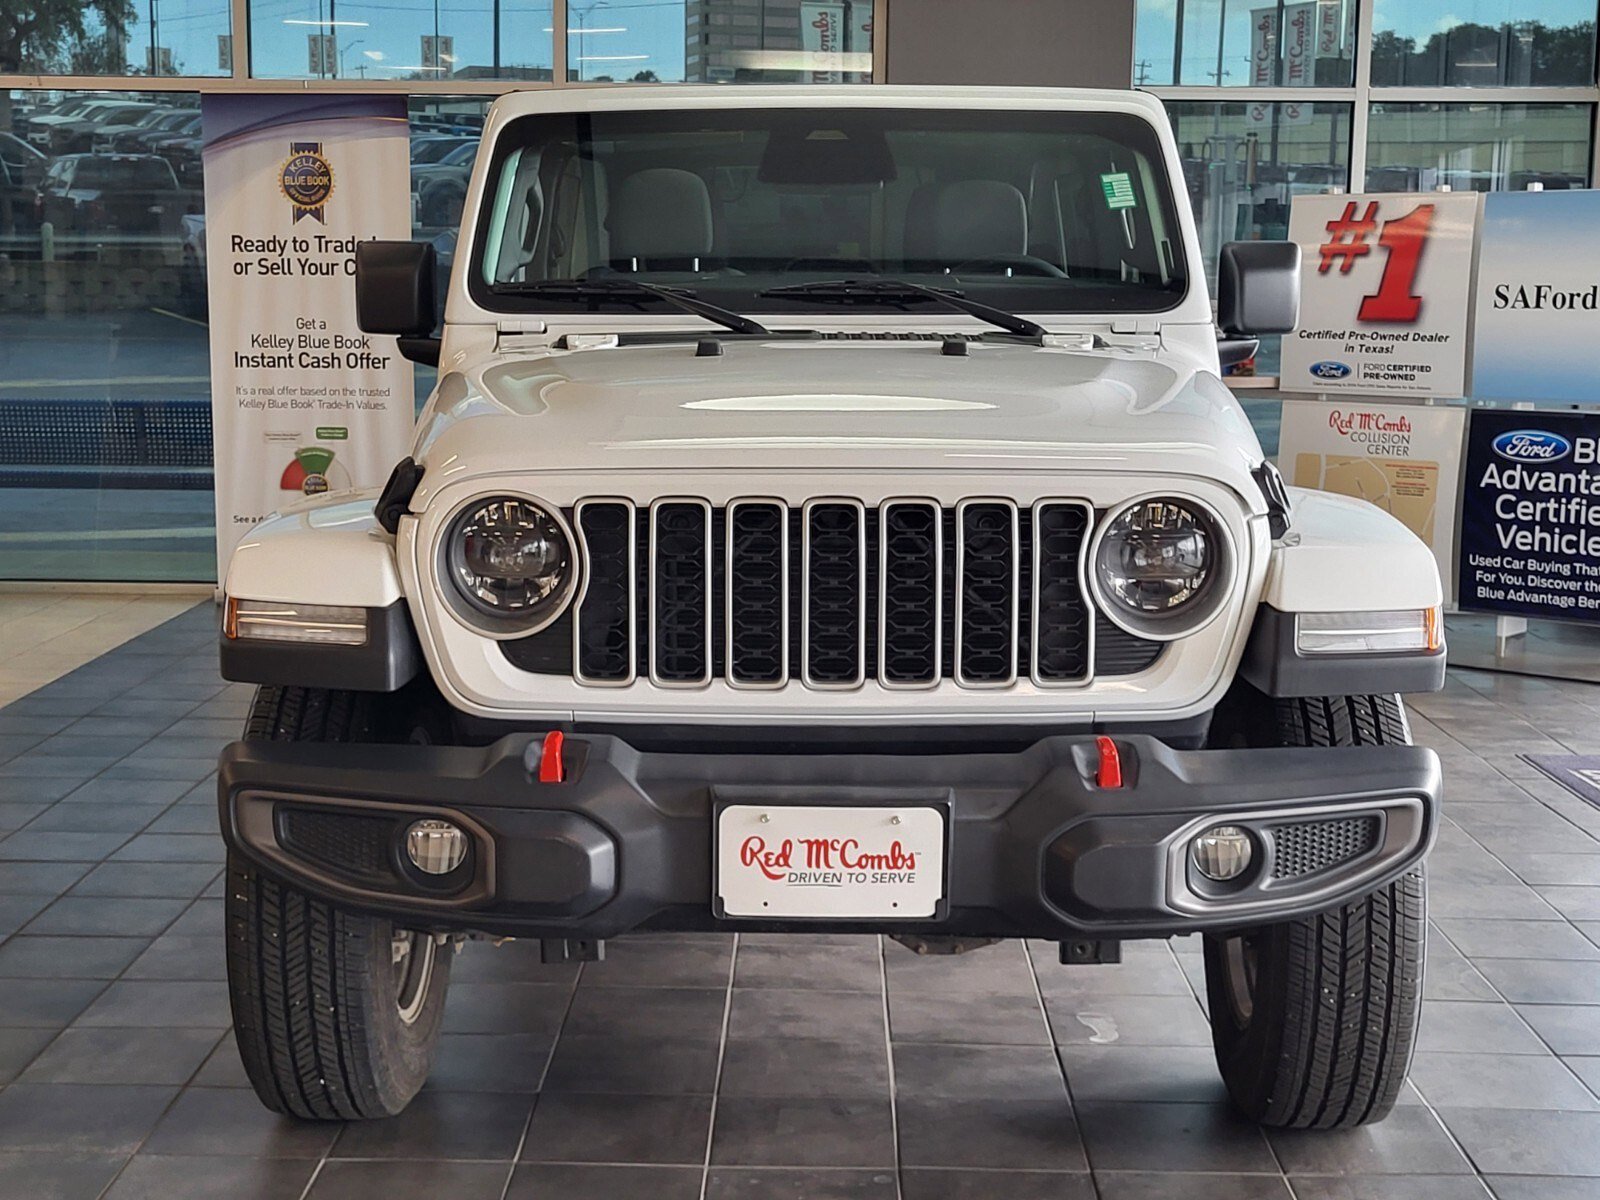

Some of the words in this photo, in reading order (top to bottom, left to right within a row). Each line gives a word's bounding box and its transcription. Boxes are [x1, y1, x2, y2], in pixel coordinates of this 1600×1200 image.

[1288, 9, 1305, 84] McCombs
[289, 157, 327, 173] KELLEY
[284, 175, 306, 186] BLUE
[306, 175, 330, 186] BOOK
[231, 235, 287, 257] Ready
[292, 236, 310, 253] to
[233, 262, 252, 276] or
[258, 258, 293, 276] Sell
[297, 259, 339, 276] Your
[1318, 201, 1434, 322] #1
[1493, 284, 1598, 311] SAFord
[296, 317, 317, 330] Get
[319, 320, 327, 330] a
[251, 334, 294, 351] Kelley
[298, 335, 330, 349] Blue
[334, 335, 370, 349] Book
[1299, 330, 1346, 340] Certified
[1348, 331, 1409, 342] Pre-Owned
[1412, 332, 1450, 343] Dealer
[1345, 343, 1354, 353] in
[1358, 344, 1395, 354] Texas!
[234, 352, 294, 368] Instant
[298, 352, 341, 369] Cash
[346, 353, 391, 370] Offer
[1363, 363, 1386, 371] FORD
[1386, 364, 1432, 373] CERTIFIED
[1363, 372, 1416, 381] PRE-OWNED
[236, 386, 248, 396] It's
[250, 388, 256, 396] a
[258, 386, 275, 396] real
[277, 386, 298, 396] offer
[300, 387, 327, 396] based
[342, 387, 356, 396] the
[359, 387, 391, 397] trusted
[239, 399, 266, 411] Kelley
[268, 399, 289, 409] Blue
[318, 400, 354, 410] Trade-In
[357, 400, 387, 410] Values.
[1329, 410, 1355, 435] Red
[1356, 412, 1412, 433] McCombs
[1350, 431, 1411, 445] COLLISION
[1505, 434, 1557, 458] Ford
[1366, 444, 1410, 456] CENTER
[1495, 493, 1600, 526] Certifie
[233, 515, 250, 523] See
[1495, 523, 1600, 557] Vehicle
[1469, 554, 1501, 568] Used
[1503, 557, 1525, 570] Car
[1527, 559, 1571, 576] Buying
[1476, 570, 1496, 582] For
[1499, 572, 1525, 586] You.
[1527, 575, 1582, 591] Discover
[1477, 586, 1505, 600] Blue
[1507, 589, 1576, 608] Advantage
[740, 836, 793, 881] Red
[797, 838, 916, 871] McCombs
[787, 872, 843, 884] DRIVEN
[847, 872, 867, 884] TO
[871, 872, 916, 884] SERVE
